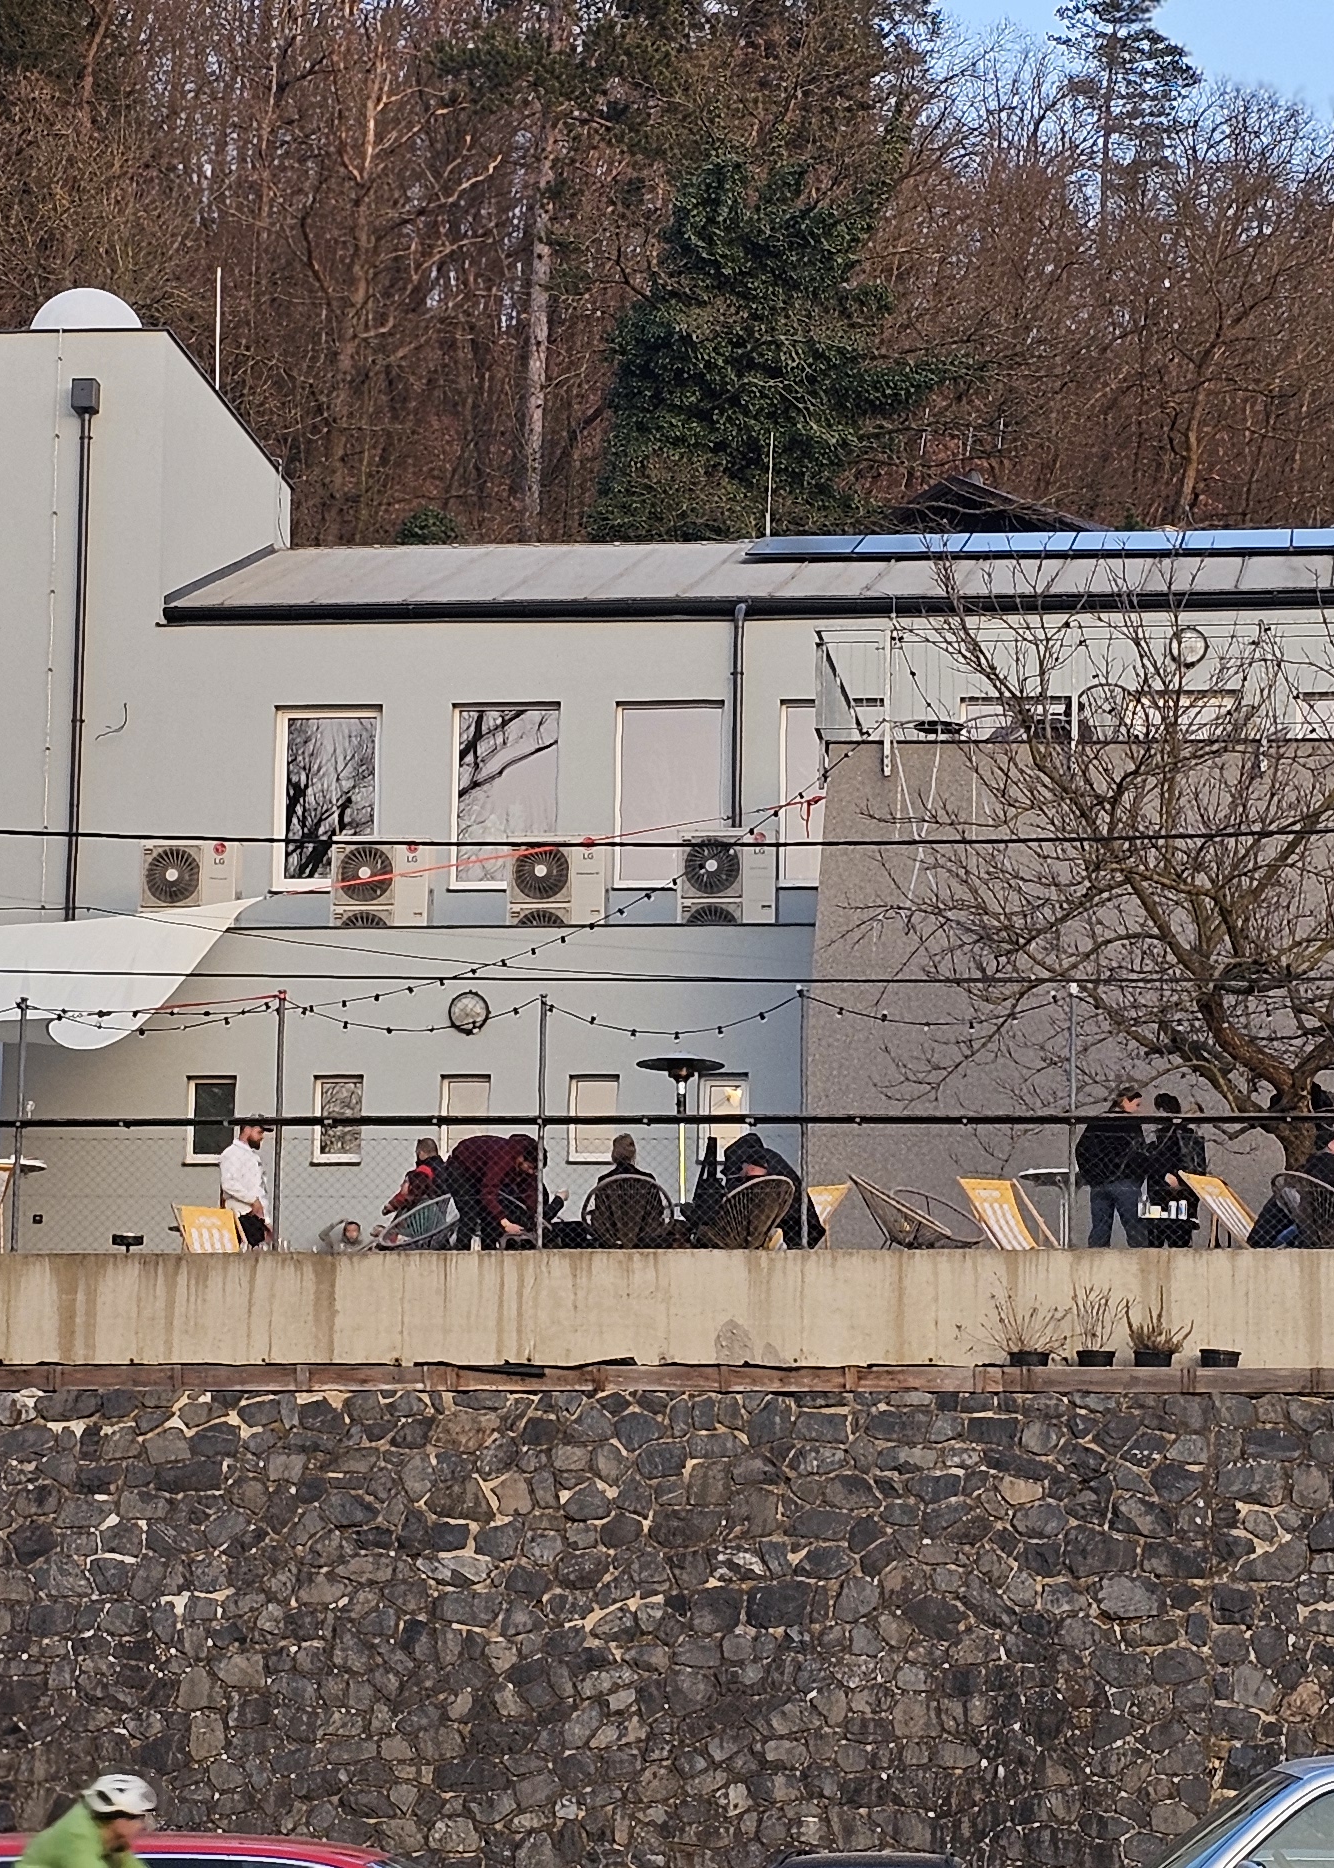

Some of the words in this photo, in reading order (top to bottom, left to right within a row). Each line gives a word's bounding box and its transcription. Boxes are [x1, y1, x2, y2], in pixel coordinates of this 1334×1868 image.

[753, 847, 766, 855] LG
[407, 855, 418, 863] LG
[582, 852, 594, 860] LG
[213, 857, 225, 865] LG
